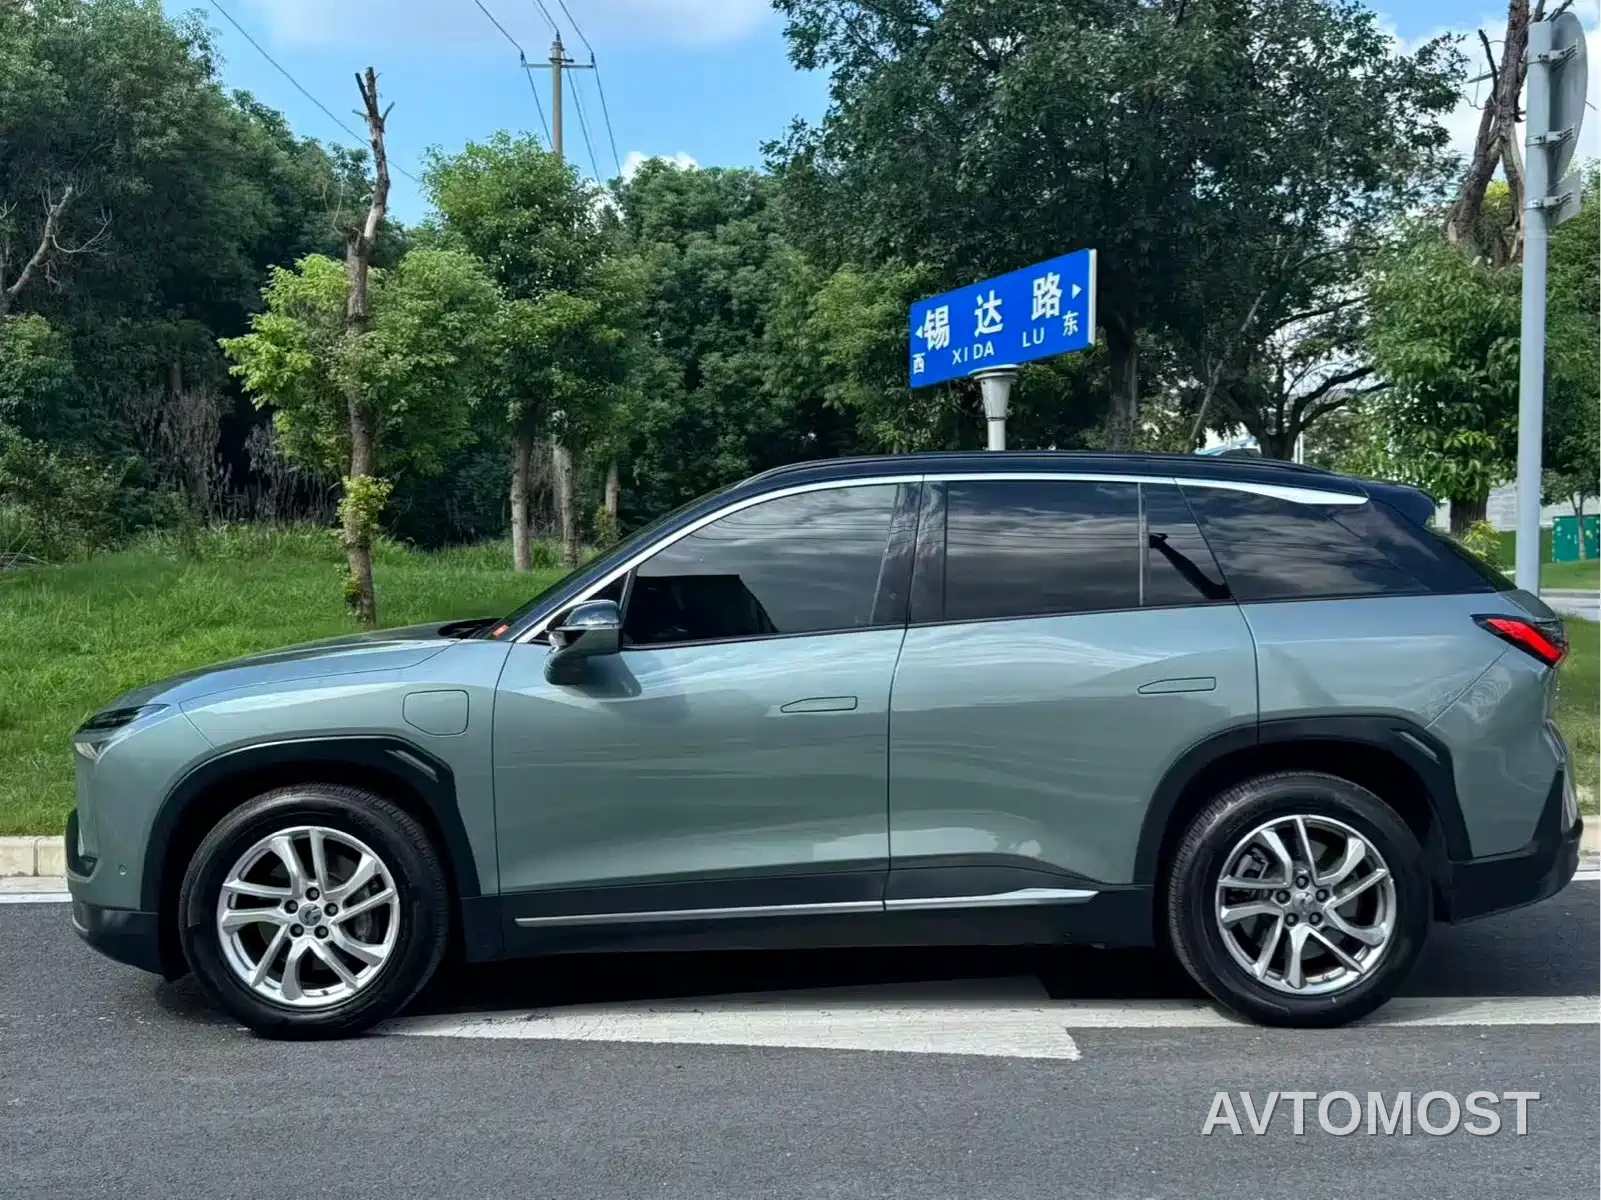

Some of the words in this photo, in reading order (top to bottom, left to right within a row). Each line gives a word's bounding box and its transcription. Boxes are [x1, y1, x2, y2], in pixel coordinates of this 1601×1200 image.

[923, 272, 1063, 351] 锡达路
[1062, 310, 1079, 336] 东
[1022, 327, 1045, 348] LU
[912, 352, 926, 374] 西
